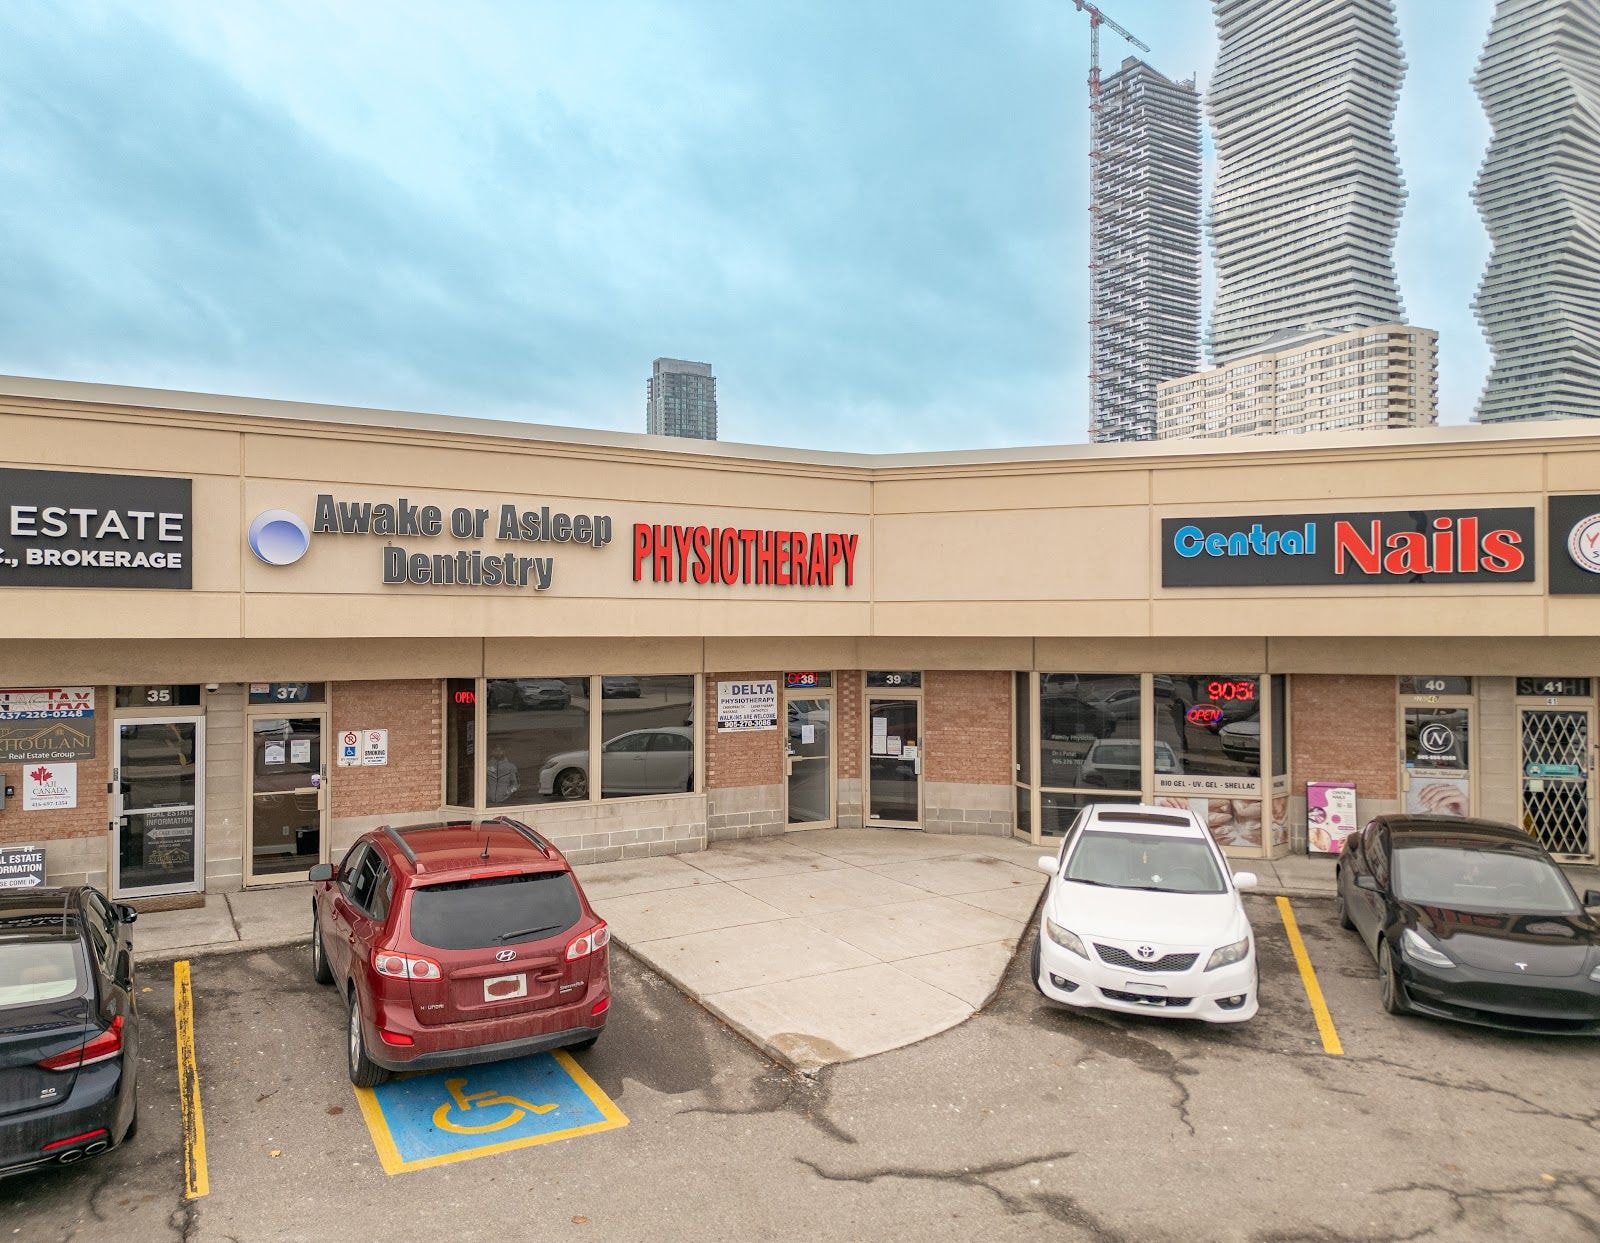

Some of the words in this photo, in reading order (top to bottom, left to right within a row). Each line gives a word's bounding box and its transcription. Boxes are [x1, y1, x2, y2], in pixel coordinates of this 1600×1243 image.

[10, 505, 184, 542] ESTATE
[312, 493, 442, 537] Awake
[449, 507, 489, 539] or
[497, 504, 613, 547] Asleep
[1174, 522, 1317, 558] Central
[1334, 516, 1526, 576] Nails
[26, 548, 182, 569] BROKERAGE
[632, 522, 858, 587] PHYSIOTHERAPY
[383, 546, 555, 591] Dentistry
[801, 674, 814, 684] 38
[886, 674, 901, 684] 39
[732, 684, 774, 695] DELTA
[1425, 680, 1445, 691] 40
[1521, 678, 1585, 694] SUHI
[1544, 681, 1563, 692] 41
[147, 689, 170, 702] 35
[277, 687, 298, 699] 37
[455, 691, 477, 704] OPEN
[0, 710, 83, 720] 437-226-0248
[1188, 709, 1220, 720] OPEN
[51, 751, 75, 760] Group
[146, 817, 193, 826] INFORMATION
[9, 853, 42, 863] ESTATE
